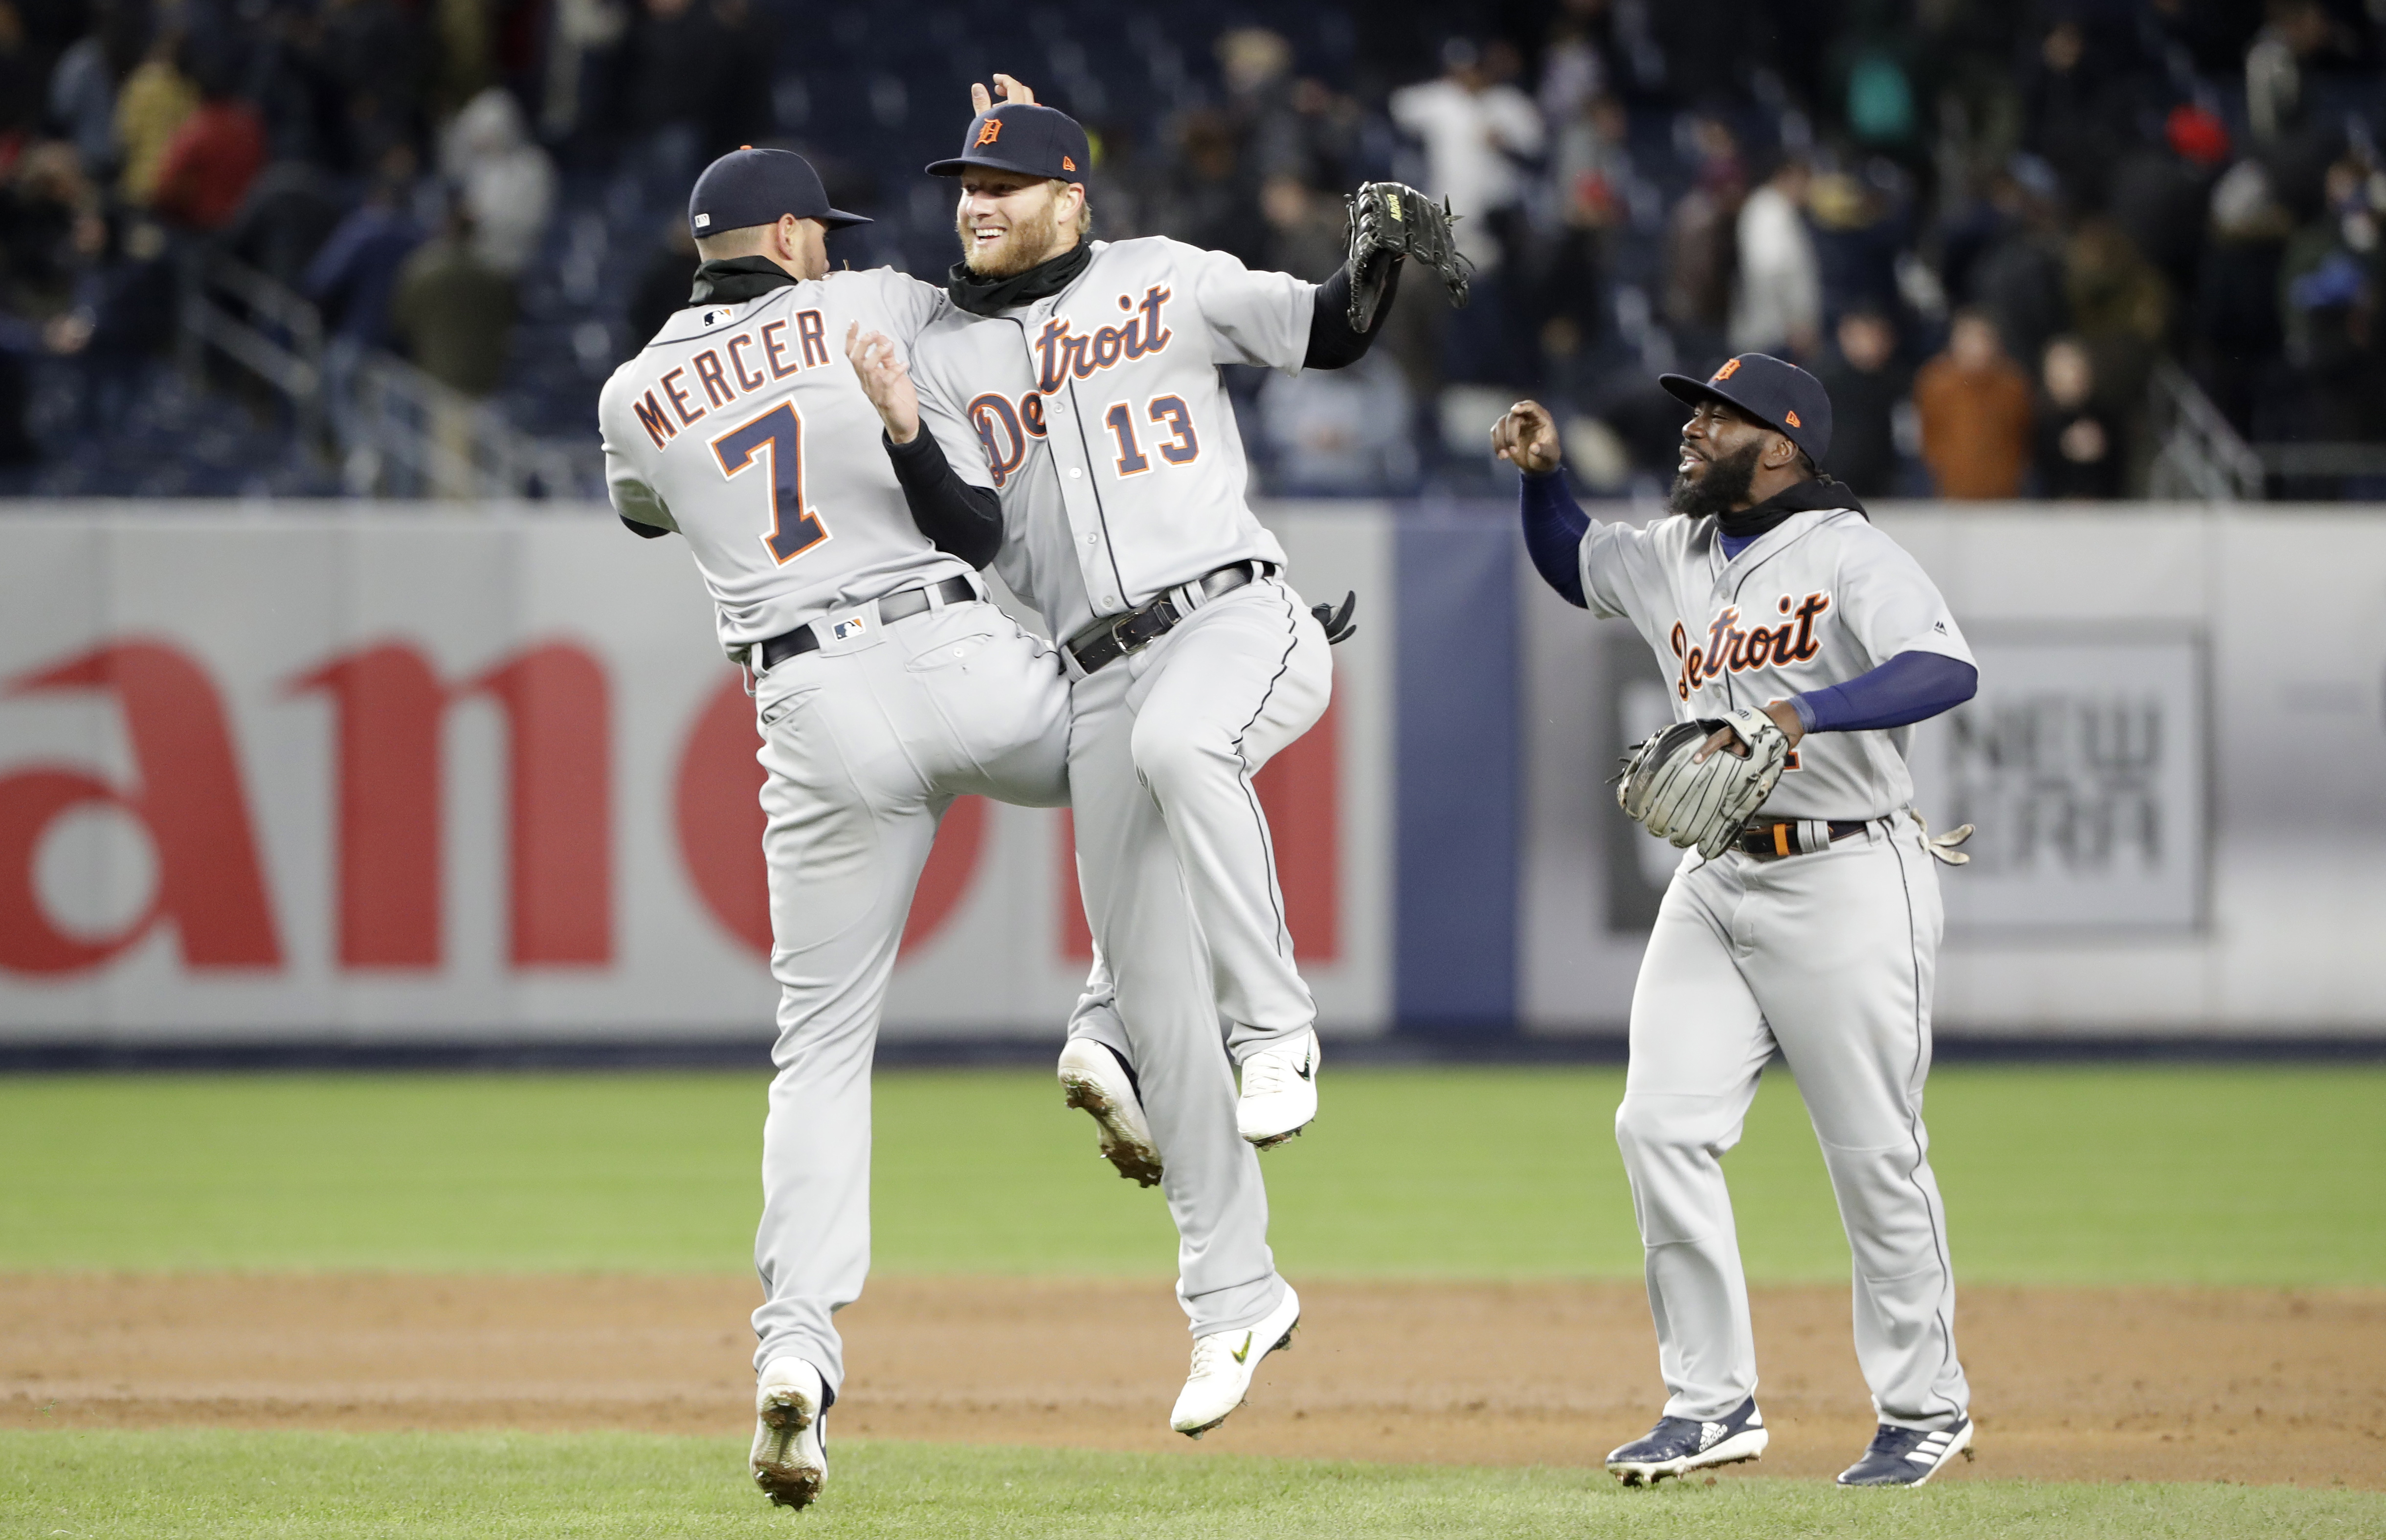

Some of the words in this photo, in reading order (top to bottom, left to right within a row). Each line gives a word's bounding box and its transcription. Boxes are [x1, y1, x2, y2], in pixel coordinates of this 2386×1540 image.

[1386, 194, 1403, 222] A2000
[631, 308, 833, 452] MERCER
[967, 281, 1173, 487] Detroit
[706, 395, 833, 569] 7
[1102, 393, 1200, 480] 13
[1670, 590, 1830, 702] Detroit
[1949, 699, 2164, 775] NEW
[1949, 777, 2164, 870] ERA
[1698, 1424, 1728, 1452] adidas
